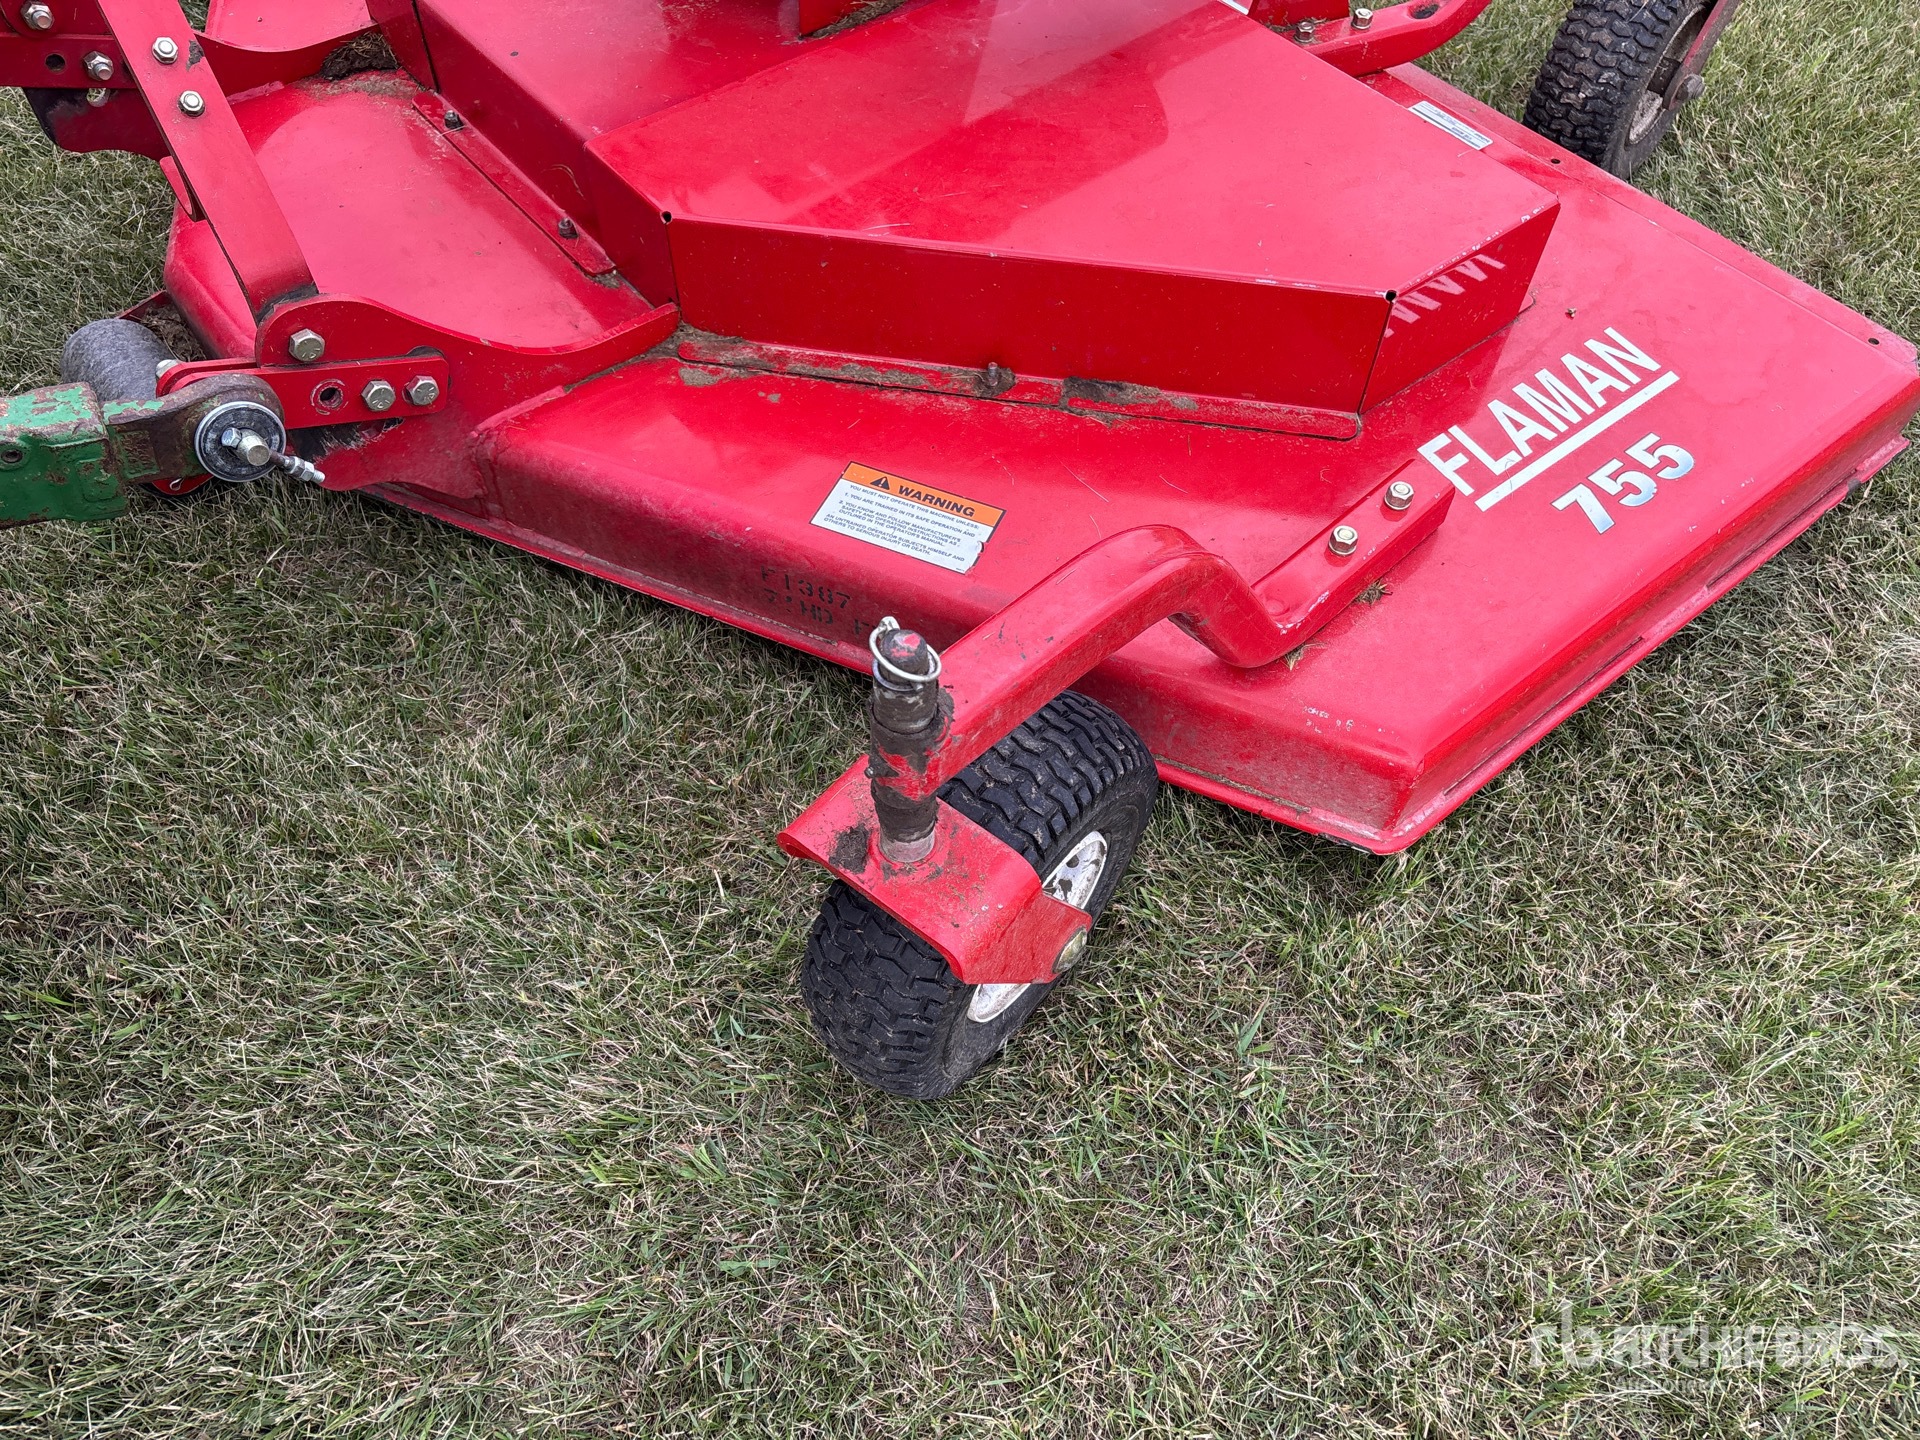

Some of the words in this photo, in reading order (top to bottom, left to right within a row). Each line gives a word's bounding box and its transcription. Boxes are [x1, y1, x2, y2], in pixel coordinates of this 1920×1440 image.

[1417, 327, 1662, 497] FLAMAN
[1551, 432, 1696, 535] 755
[874, 503, 898, 512] TRAINED
[930, 521, 962, 533] OPERATION
[890, 498, 915, 508] OPERATE
[930, 511, 955, 521] MACHINE
[956, 519, 979, 529] UNLESS:
[899, 486, 976, 518] WARNING
[824, 518, 846, 527] OTHERS
[856, 528, 880, 538] SERIOUS
[881, 536, 901, 545] INJURY
[911, 547, 931, 555] DEATH.
[835, 517, 866, 529] UNTRAINED
[867, 527, 897, 539] OPERATOR
[898, 538, 927, 549] SUBJECTS
[928, 547, 952, 557] HIMSELF
[839, 510, 866, 520] OUTLINED
[886, 525, 920, 538] OPERATOR'S
[921, 536, 946, 546] MANUAL.
[842, 506, 862, 514] SAFETY
[875, 517, 907, 529] OPERATING
[908, 527, 948, 542] INSTRUCTIONS
[857, 506, 874, 514] KNOW
[888, 516, 910, 525] FOLLOW
[912, 524, 961, 542] MANUFACTURER'S
